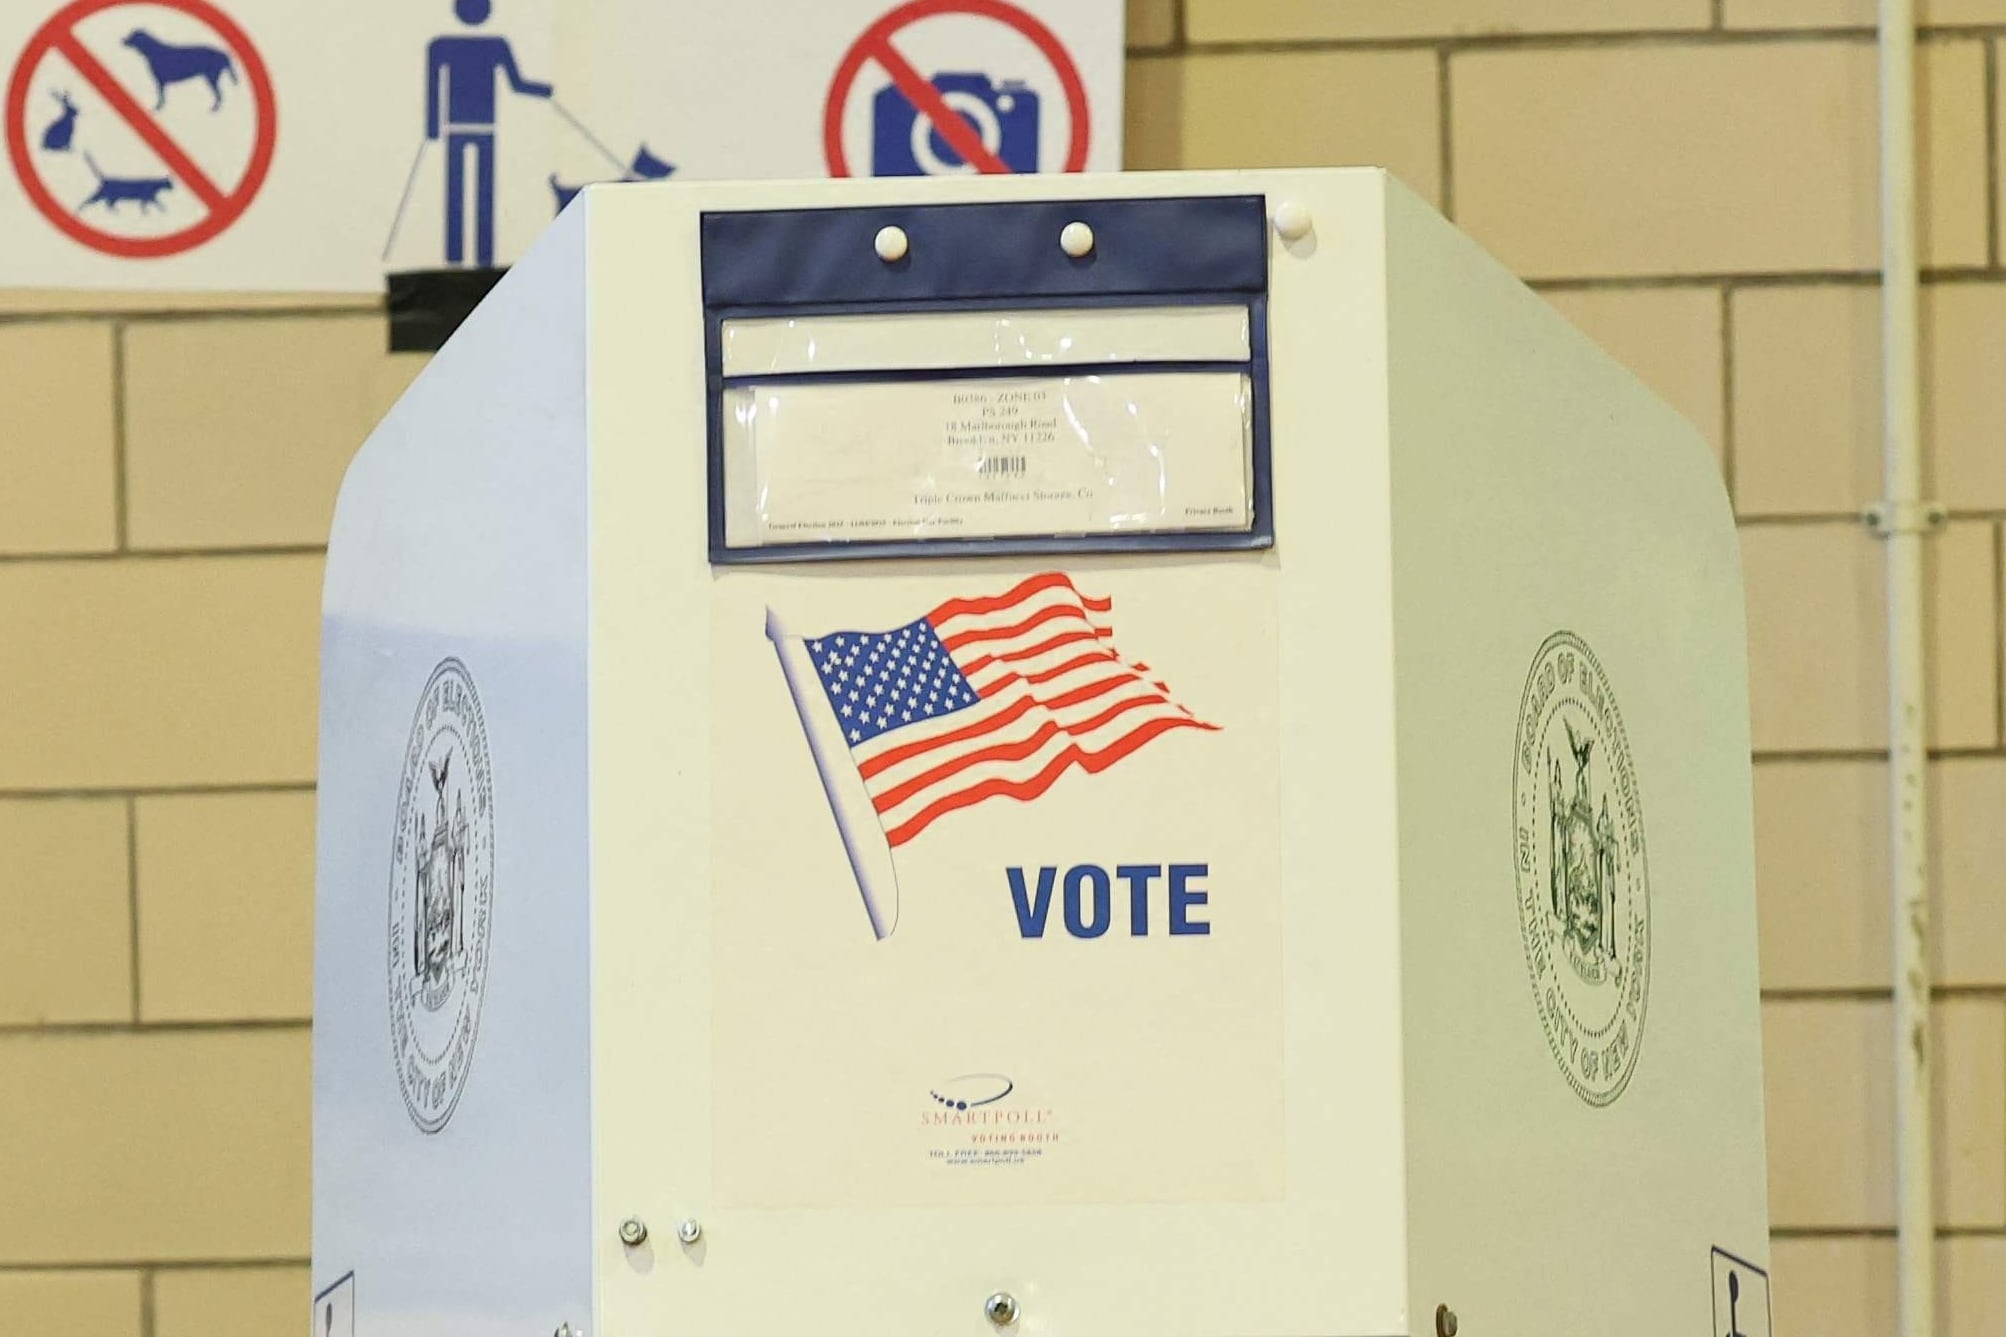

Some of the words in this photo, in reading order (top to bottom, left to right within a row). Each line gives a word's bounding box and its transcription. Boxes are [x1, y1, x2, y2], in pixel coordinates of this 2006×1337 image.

[1557, 651, 1575, 685] OF
[1005, 863, 1211, 939] VOTE
[971, 1133, 1016, 1145] VOTING
[1019, 1131, 1060, 1143] BOOTH
